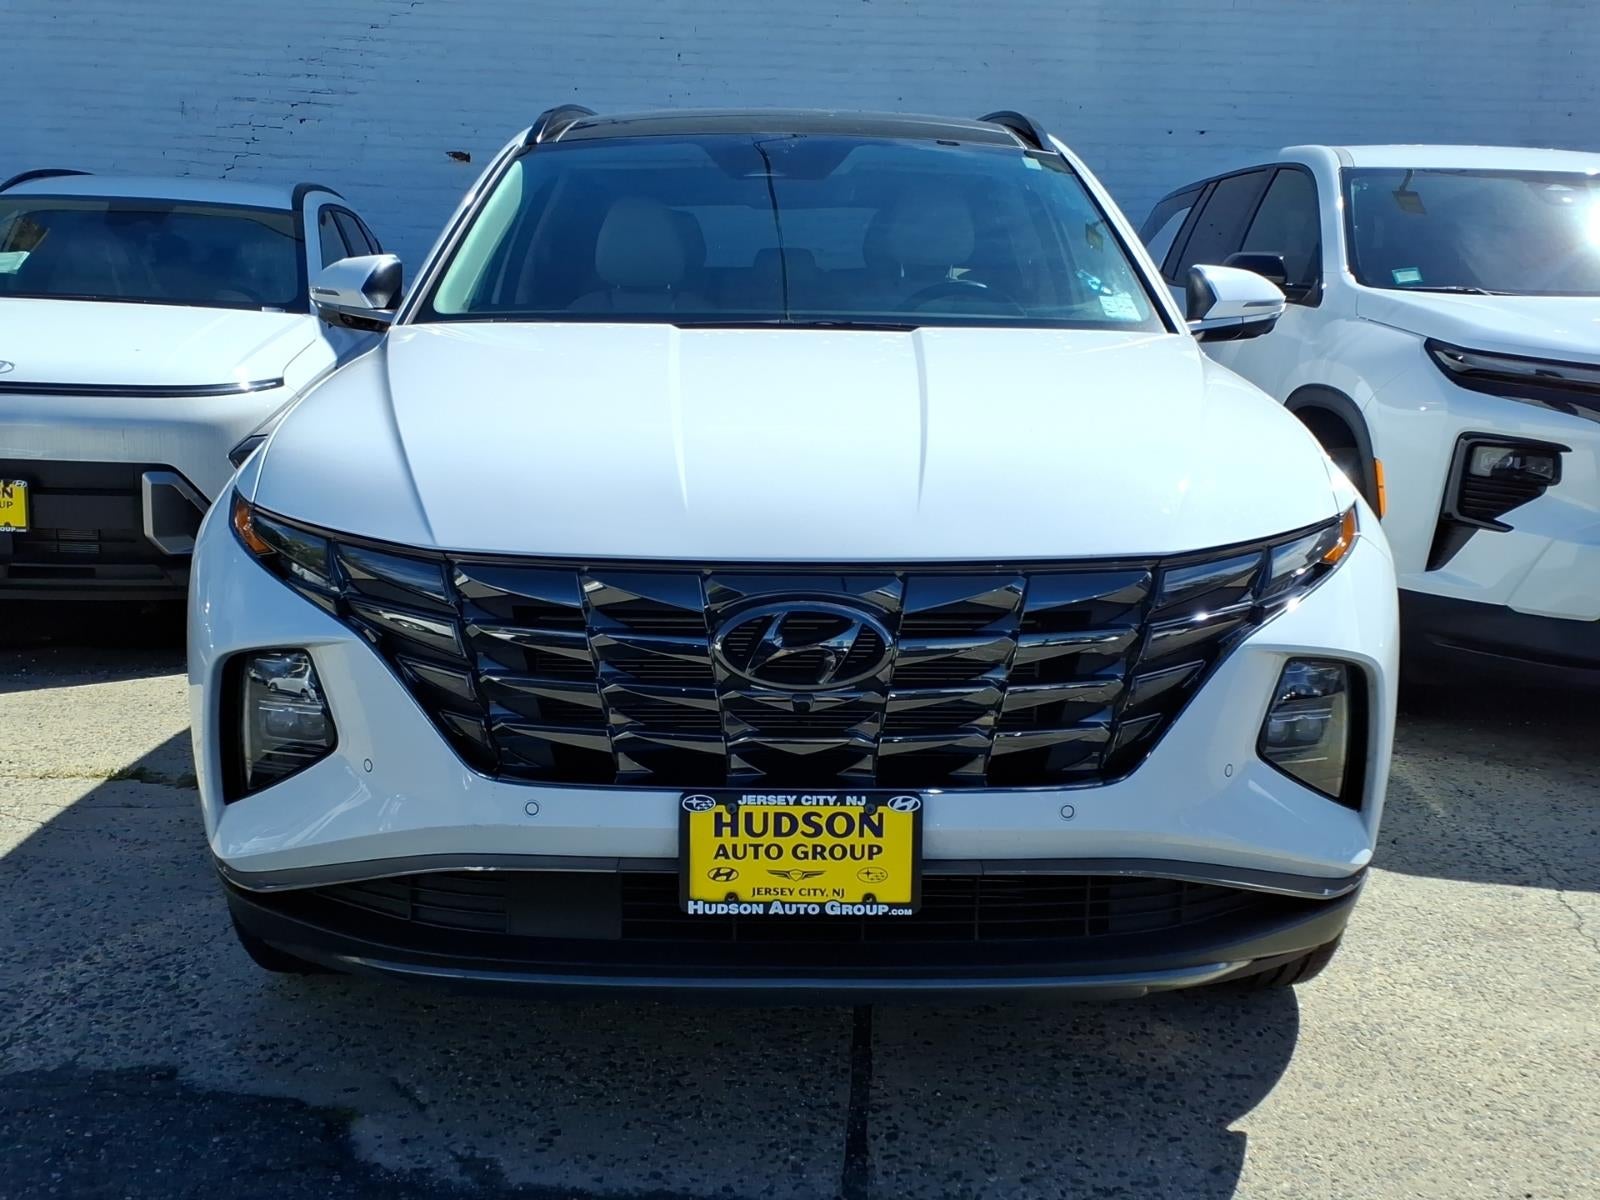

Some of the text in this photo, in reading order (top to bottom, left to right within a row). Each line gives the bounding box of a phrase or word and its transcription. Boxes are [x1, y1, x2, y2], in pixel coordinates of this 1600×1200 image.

[738, 795, 866, 807] JERSEY CITY, NJ
[714, 811, 884, 838] HUDSON
[713, 843, 883, 861] AUTO GROUP
[751, 887, 795, 897] JERSEY
[833, 888, 845, 898] NJ
